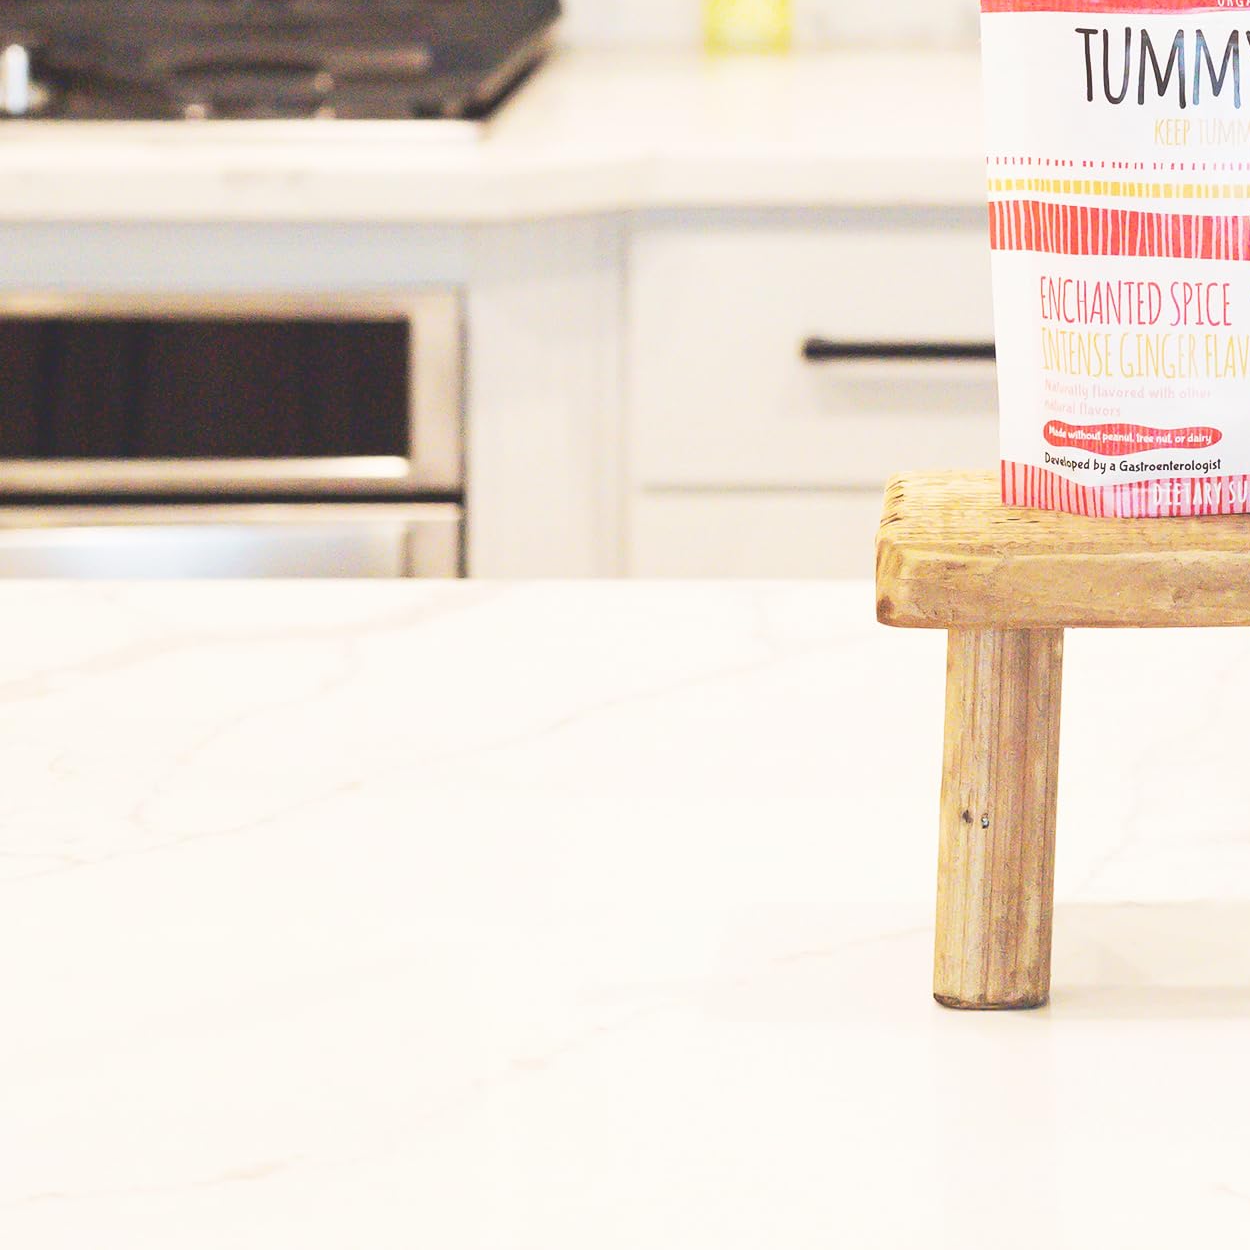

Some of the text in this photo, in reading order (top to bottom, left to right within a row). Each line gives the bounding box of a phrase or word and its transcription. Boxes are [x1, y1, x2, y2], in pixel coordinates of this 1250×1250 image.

[1154, 118, 1191, 146] KEEP
[1040, 276, 1232, 326] ENCHANTED SPICE
[1041, 327, 1113, 378] INTENSE
[1119, 333, 1200, 379] GINGER
[1044, 379, 1088, 400] Naturally
[1092, 383, 1144, 399] flavored
[1149, 385, 1175, 399] with
[1079, 400, 1121, 417] flavors
[1048, 425, 1066, 439] Made
[1068, 428, 1100, 441] without
[1136, 432, 1154, 444] tree
[1174, 435, 1186, 444] or
[1187, 432, 1212, 446] dairy
[1045, 452, 1221, 474] Developed by a Gastroenterologist
[1152, 482, 1222, 506] DIETARY
